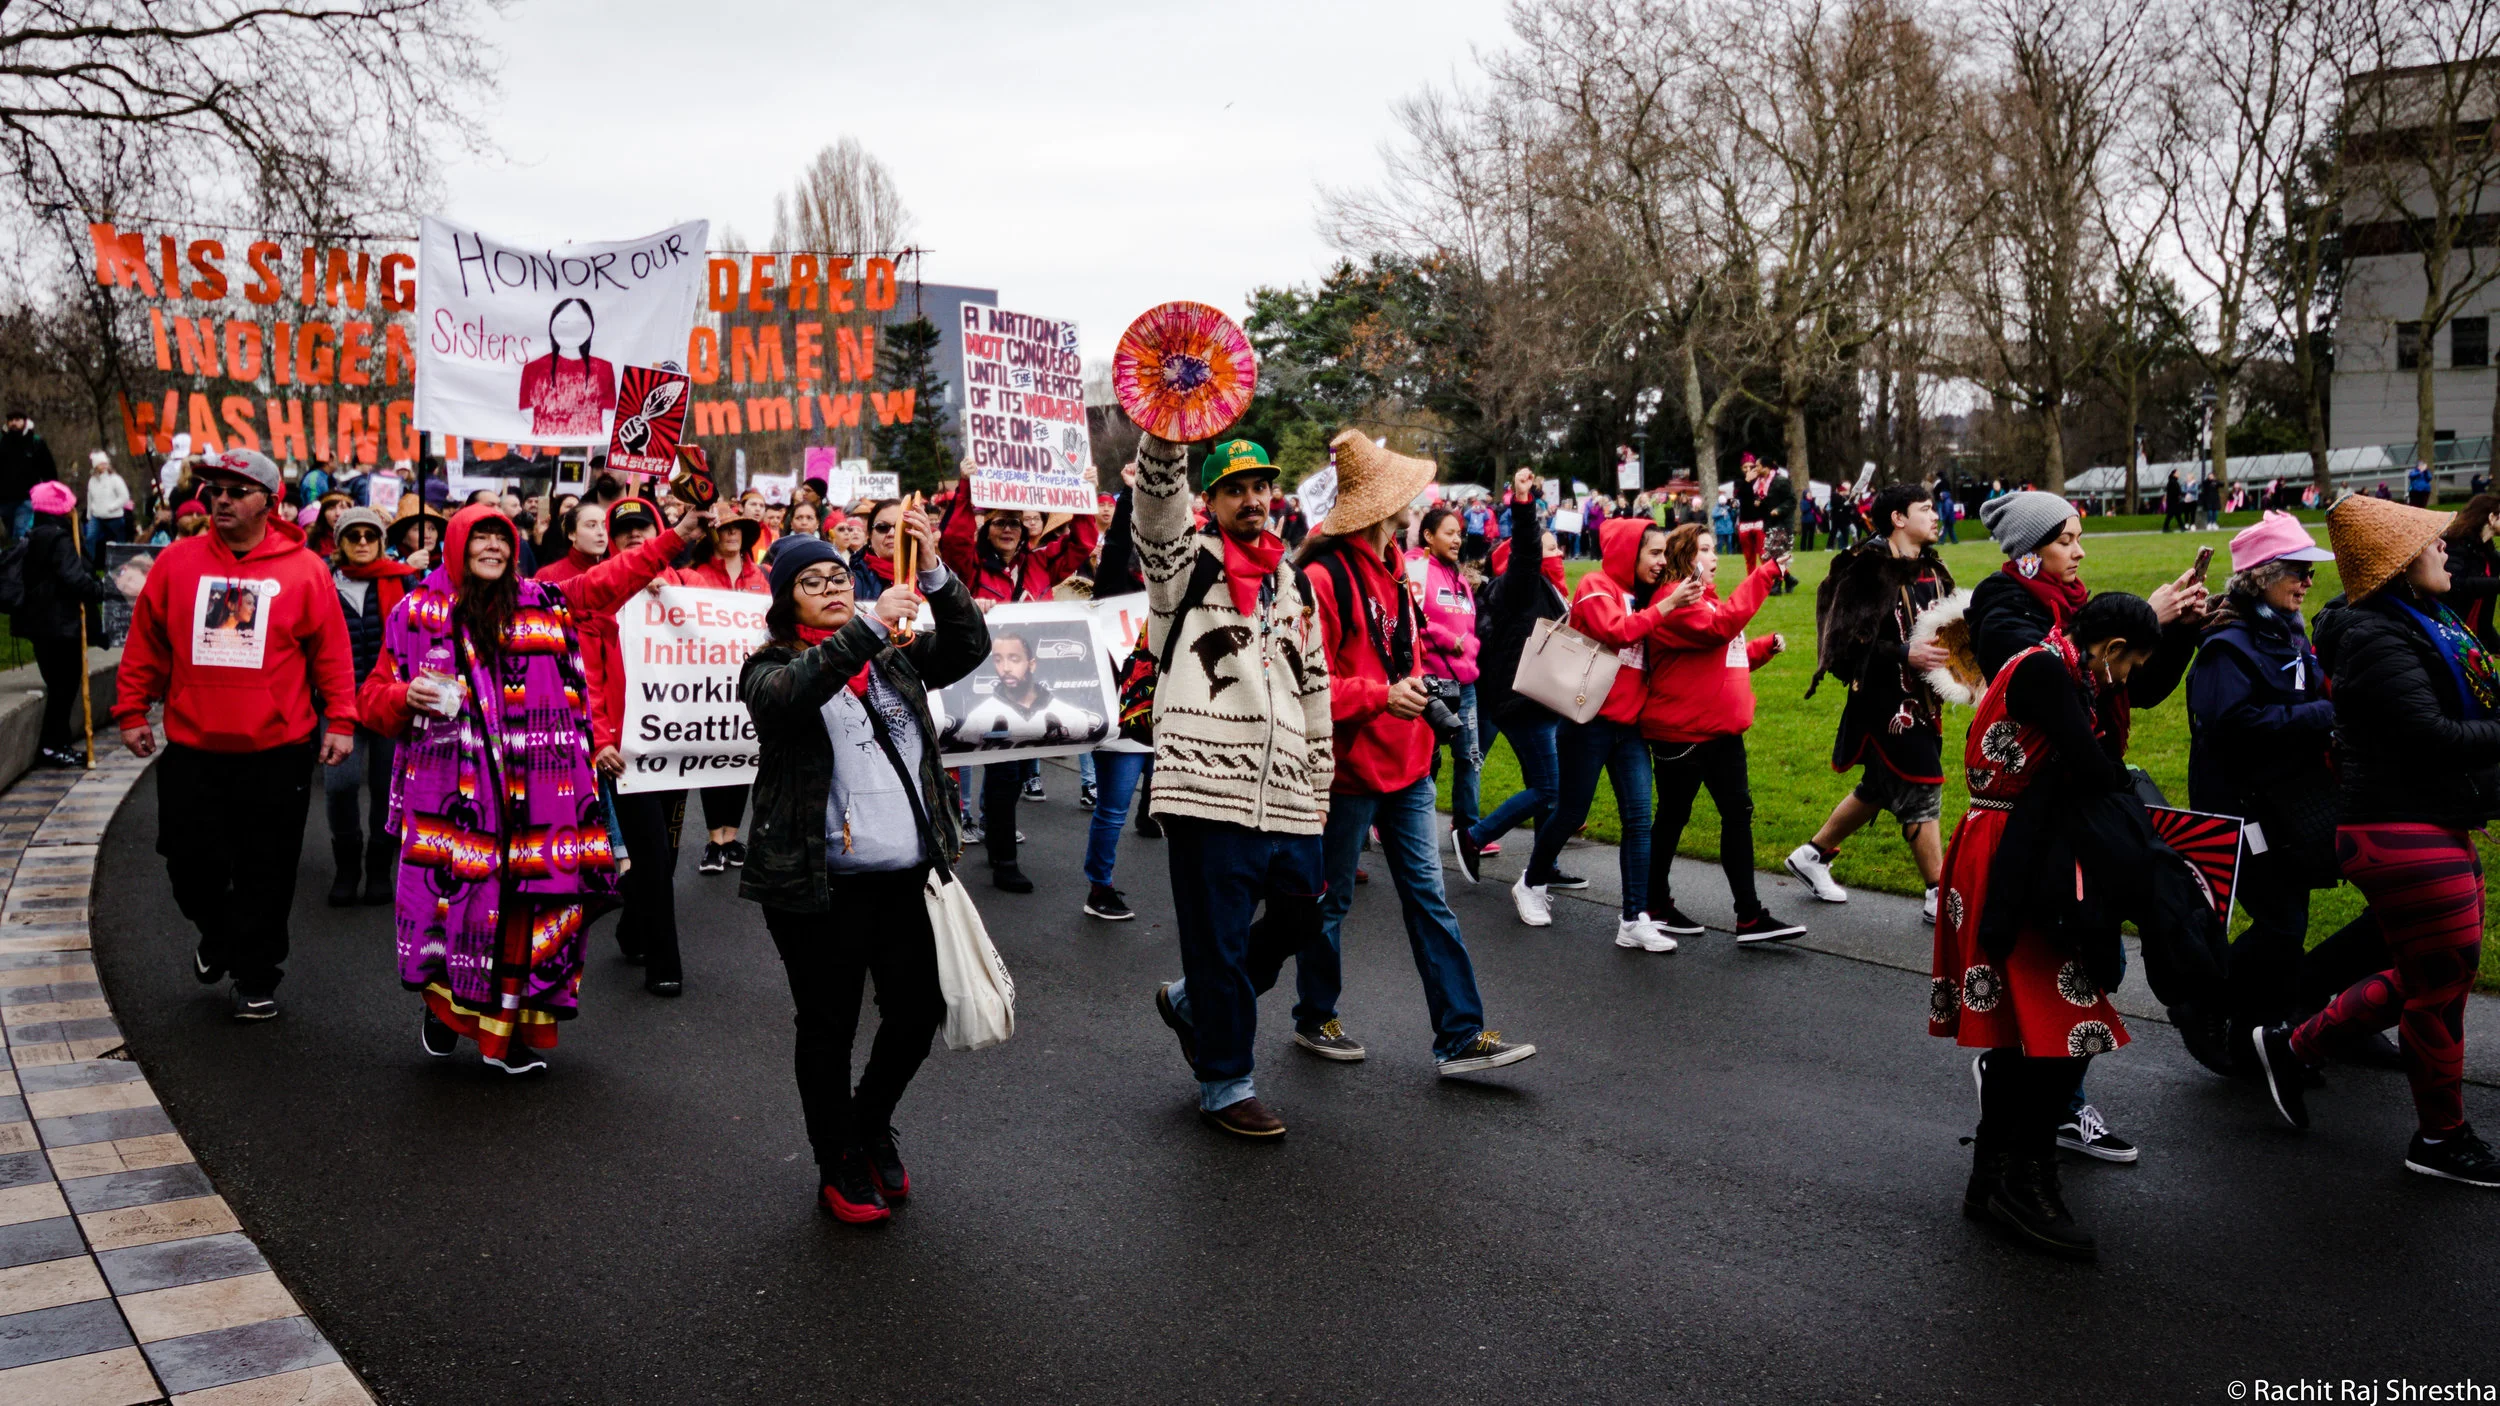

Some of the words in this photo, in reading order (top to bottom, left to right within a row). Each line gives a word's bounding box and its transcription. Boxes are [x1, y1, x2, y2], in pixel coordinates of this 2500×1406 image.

[89, 223, 417, 313] MISSING
[708, 253, 898, 314] DERED
[452, 231, 629, 297] HONOR
[631, 233, 690, 279] OUR
[431, 308, 531, 365] Sisters
[964, 306, 980, 330] A
[989, 309, 1060, 348] NATION
[150, 307, 417, 386] INDIGEN
[687, 321, 875, 386] OMEN
[965, 333, 1004, 362] NOT
[1006, 339, 1081, 377] CONQUERED
[967, 361, 1011, 388] UNTIL
[1013, 371, 1032, 385] THE
[1033, 371, 1084, 400] HEARTS
[118, 390, 562, 465] WASHING
[694, 378, 916, 437] mmiww
[970, 387, 991, 410] OF
[999, 393, 1022, 413] ITS
[1023, 392, 1086, 427] WOMEN
[971, 414, 1006, 439] ARE
[1010, 417, 1033, 444] ON
[611, 453, 629, 467] WE
[628, 460, 671, 472] SILENT
[972, 480, 1091, 509] #HONORTHEWOMEN
[644, 600, 768, 630] De-Esca
[643, 637, 760, 665] Initiati
[641, 676, 741, 703] worki
[1053, 680, 1099, 689] BOEING
[635, 753, 668, 773] to
[679, 752, 761, 777] prese
